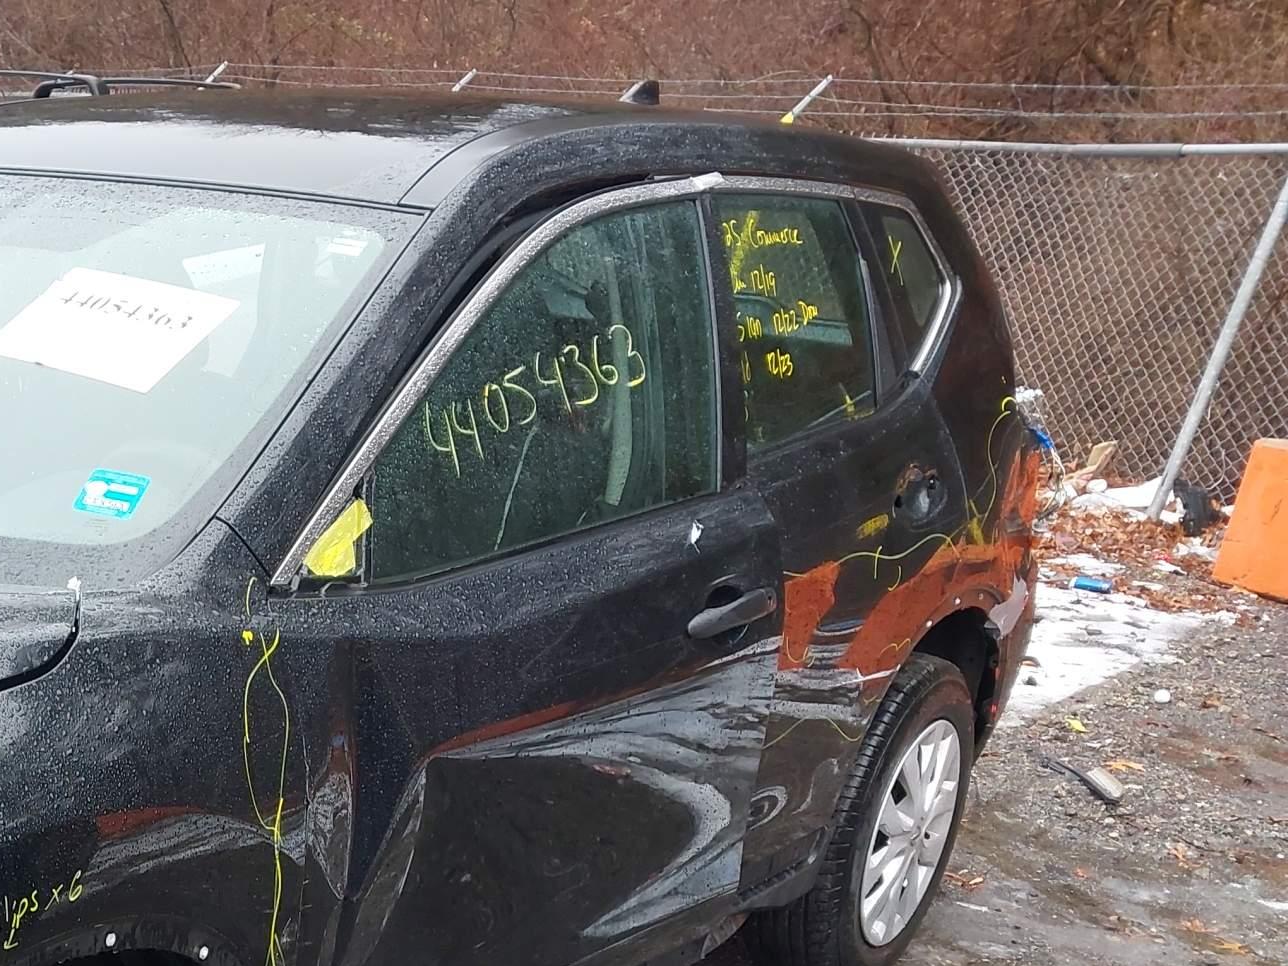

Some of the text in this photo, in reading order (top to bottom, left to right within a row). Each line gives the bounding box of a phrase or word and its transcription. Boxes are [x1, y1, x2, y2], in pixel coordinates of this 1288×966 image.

[751, 264, 777, 296] 12/19
[773, 307, 800, 337] 12/22
[766, 348, 794, 378] 12/23
[425, 324, 646, 478] 44054363
